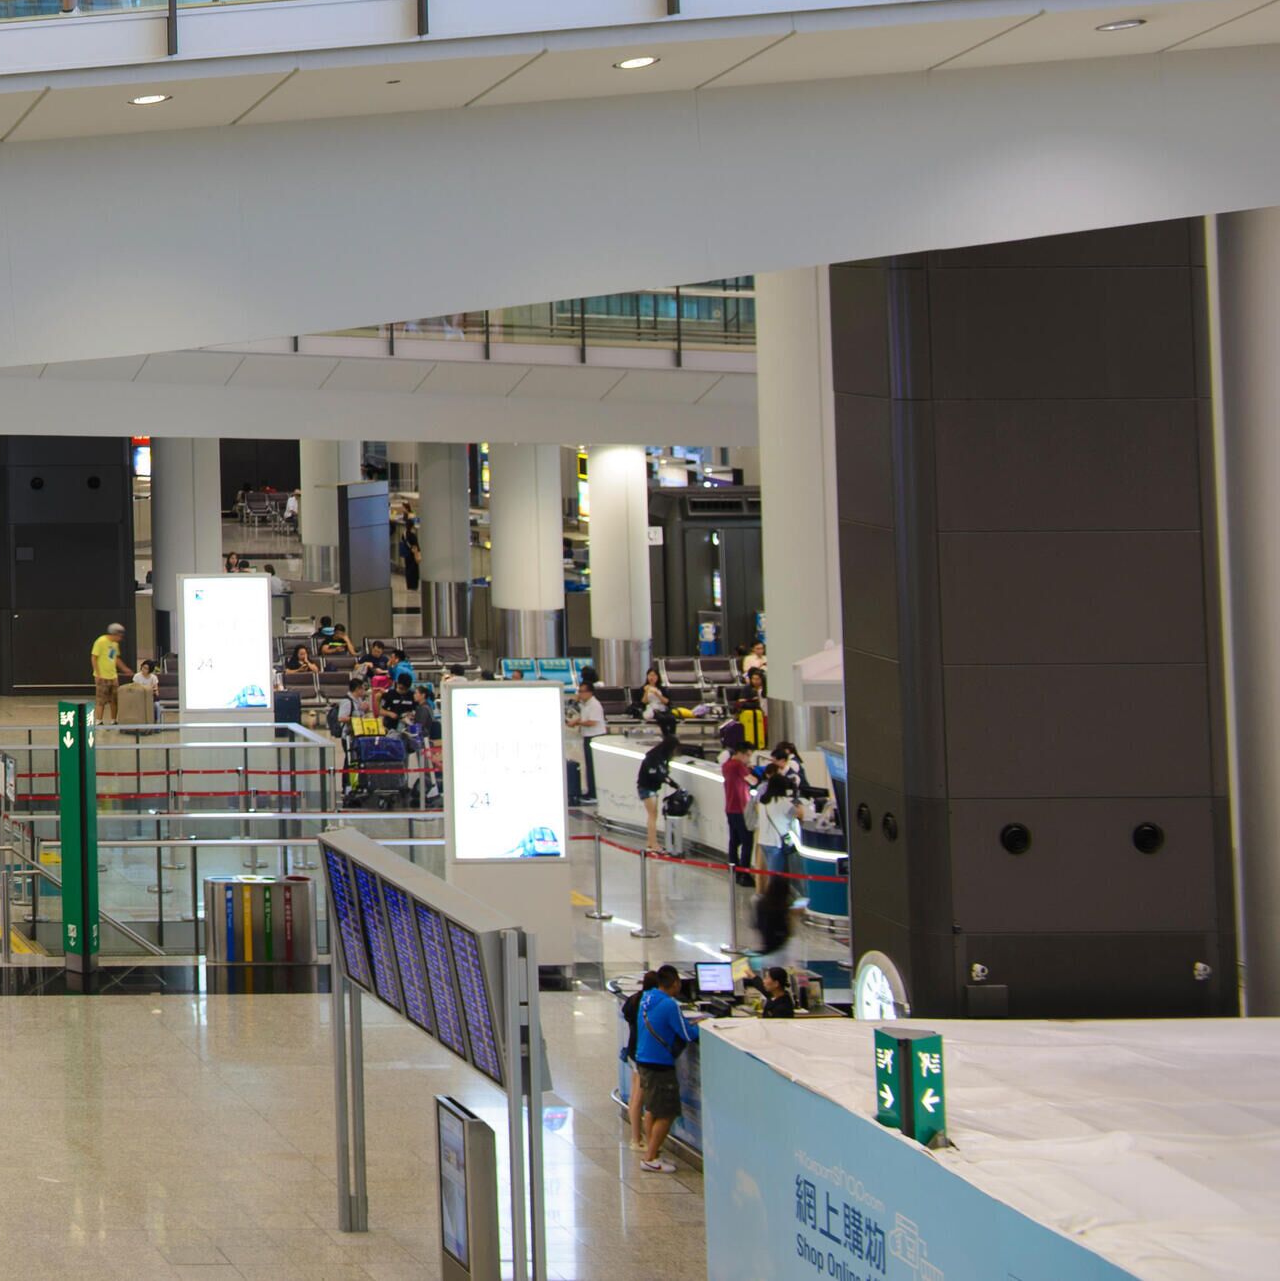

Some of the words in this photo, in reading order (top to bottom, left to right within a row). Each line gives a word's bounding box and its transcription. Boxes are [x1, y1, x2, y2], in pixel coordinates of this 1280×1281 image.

[795, 1173, 887, 1275] 網上購物
[796, 1232, 824, 1274] Shop
